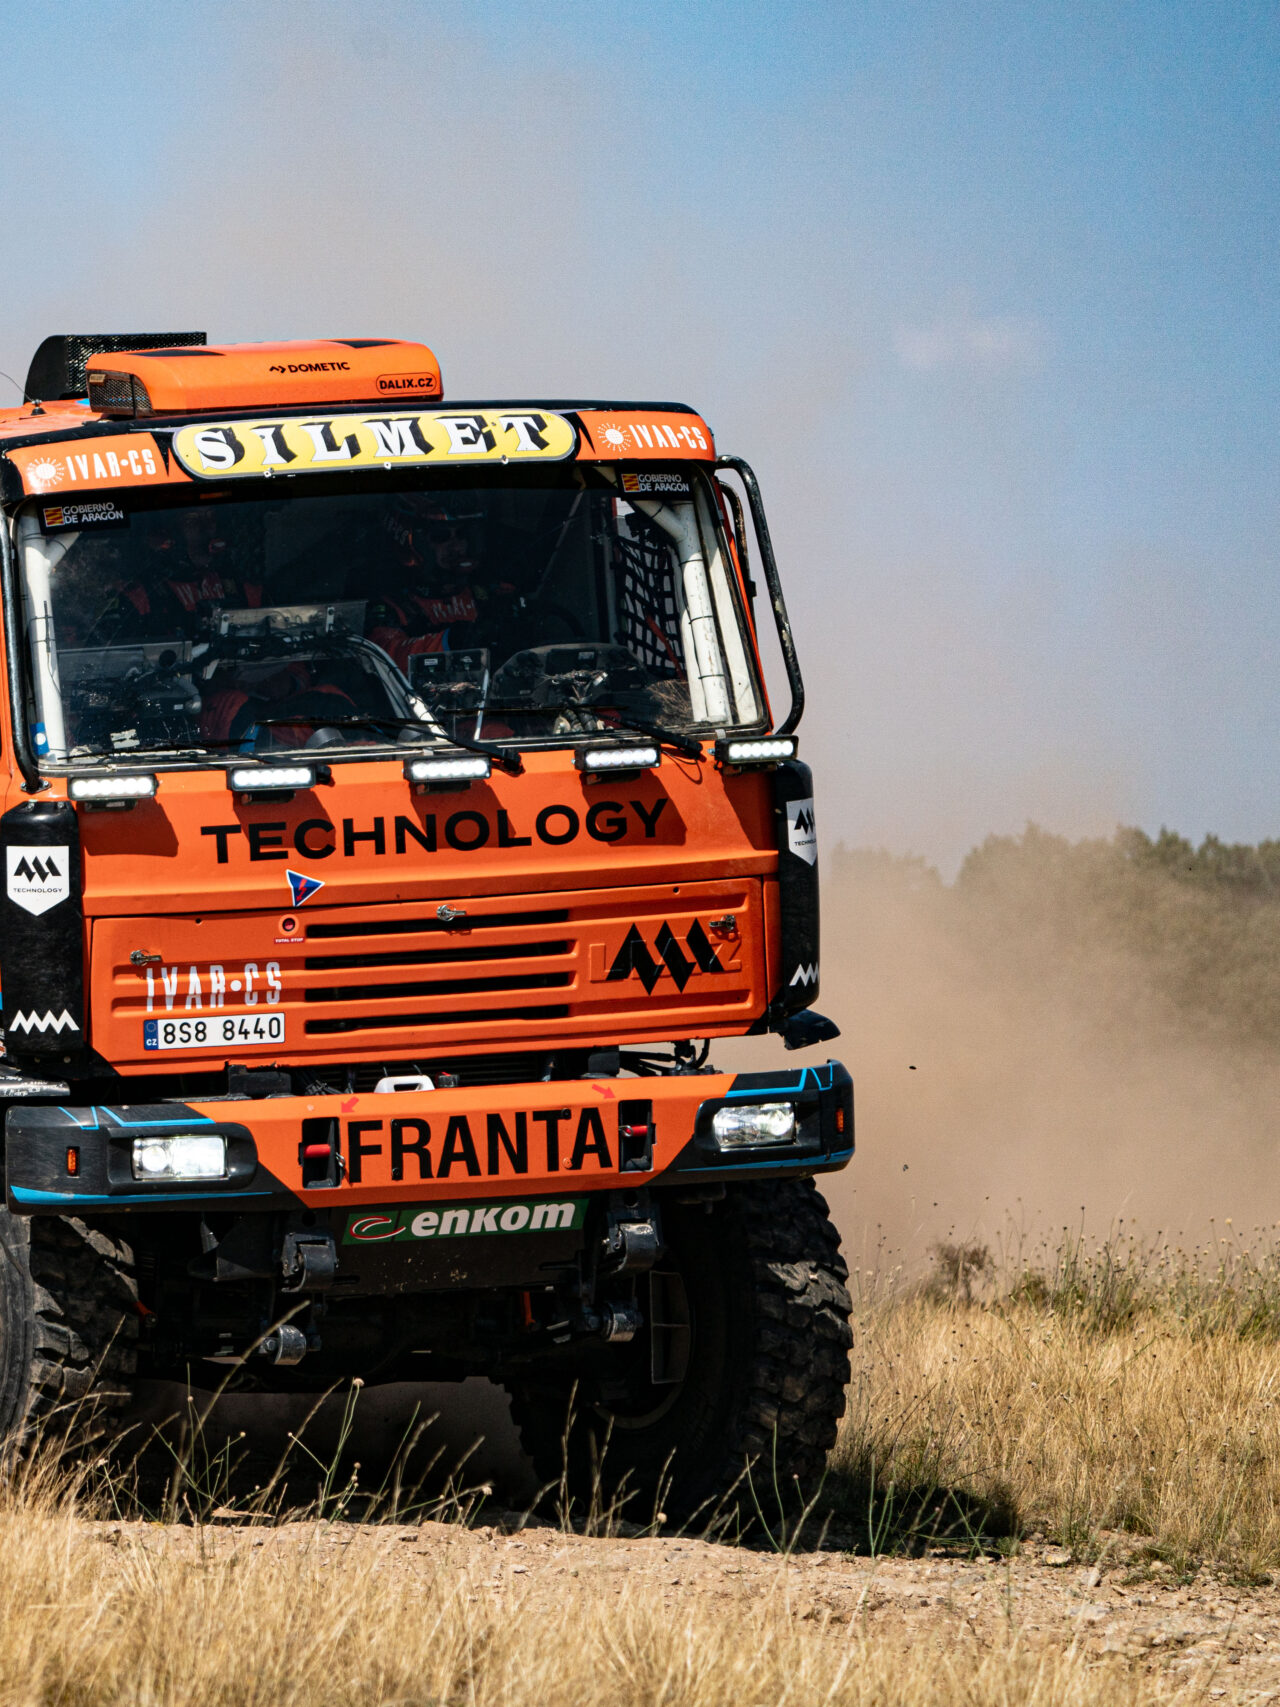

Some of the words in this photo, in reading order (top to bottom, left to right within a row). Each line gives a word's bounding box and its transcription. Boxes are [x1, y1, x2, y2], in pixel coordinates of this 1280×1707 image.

[288, 361, 350, 374] DOMETIC
[379, 377, 434, 390] DALIX.CZ
[194, 413, 550, 472] SILMET
[638, 474, 682, 484] GOBIERNO
[639, 483, 652, 492] DE
[654, 482, 690, 493] ARAGON
[63, 502, 115, 517] GOBIERNO
[64, 514, 79, 525] DE
[81, 509, 124, 522] ARAGON
[200, 798, 669, 864] TECHNOLOGY
[162, 1021, 207, 1044] 8S8
[222, 1016, 282, 1040] 8440
[146, 1038, 158, 1046] CZ
[347, 1106, 613, 1184] FRANTA
[410, 1202, 576, 1238] enkom
